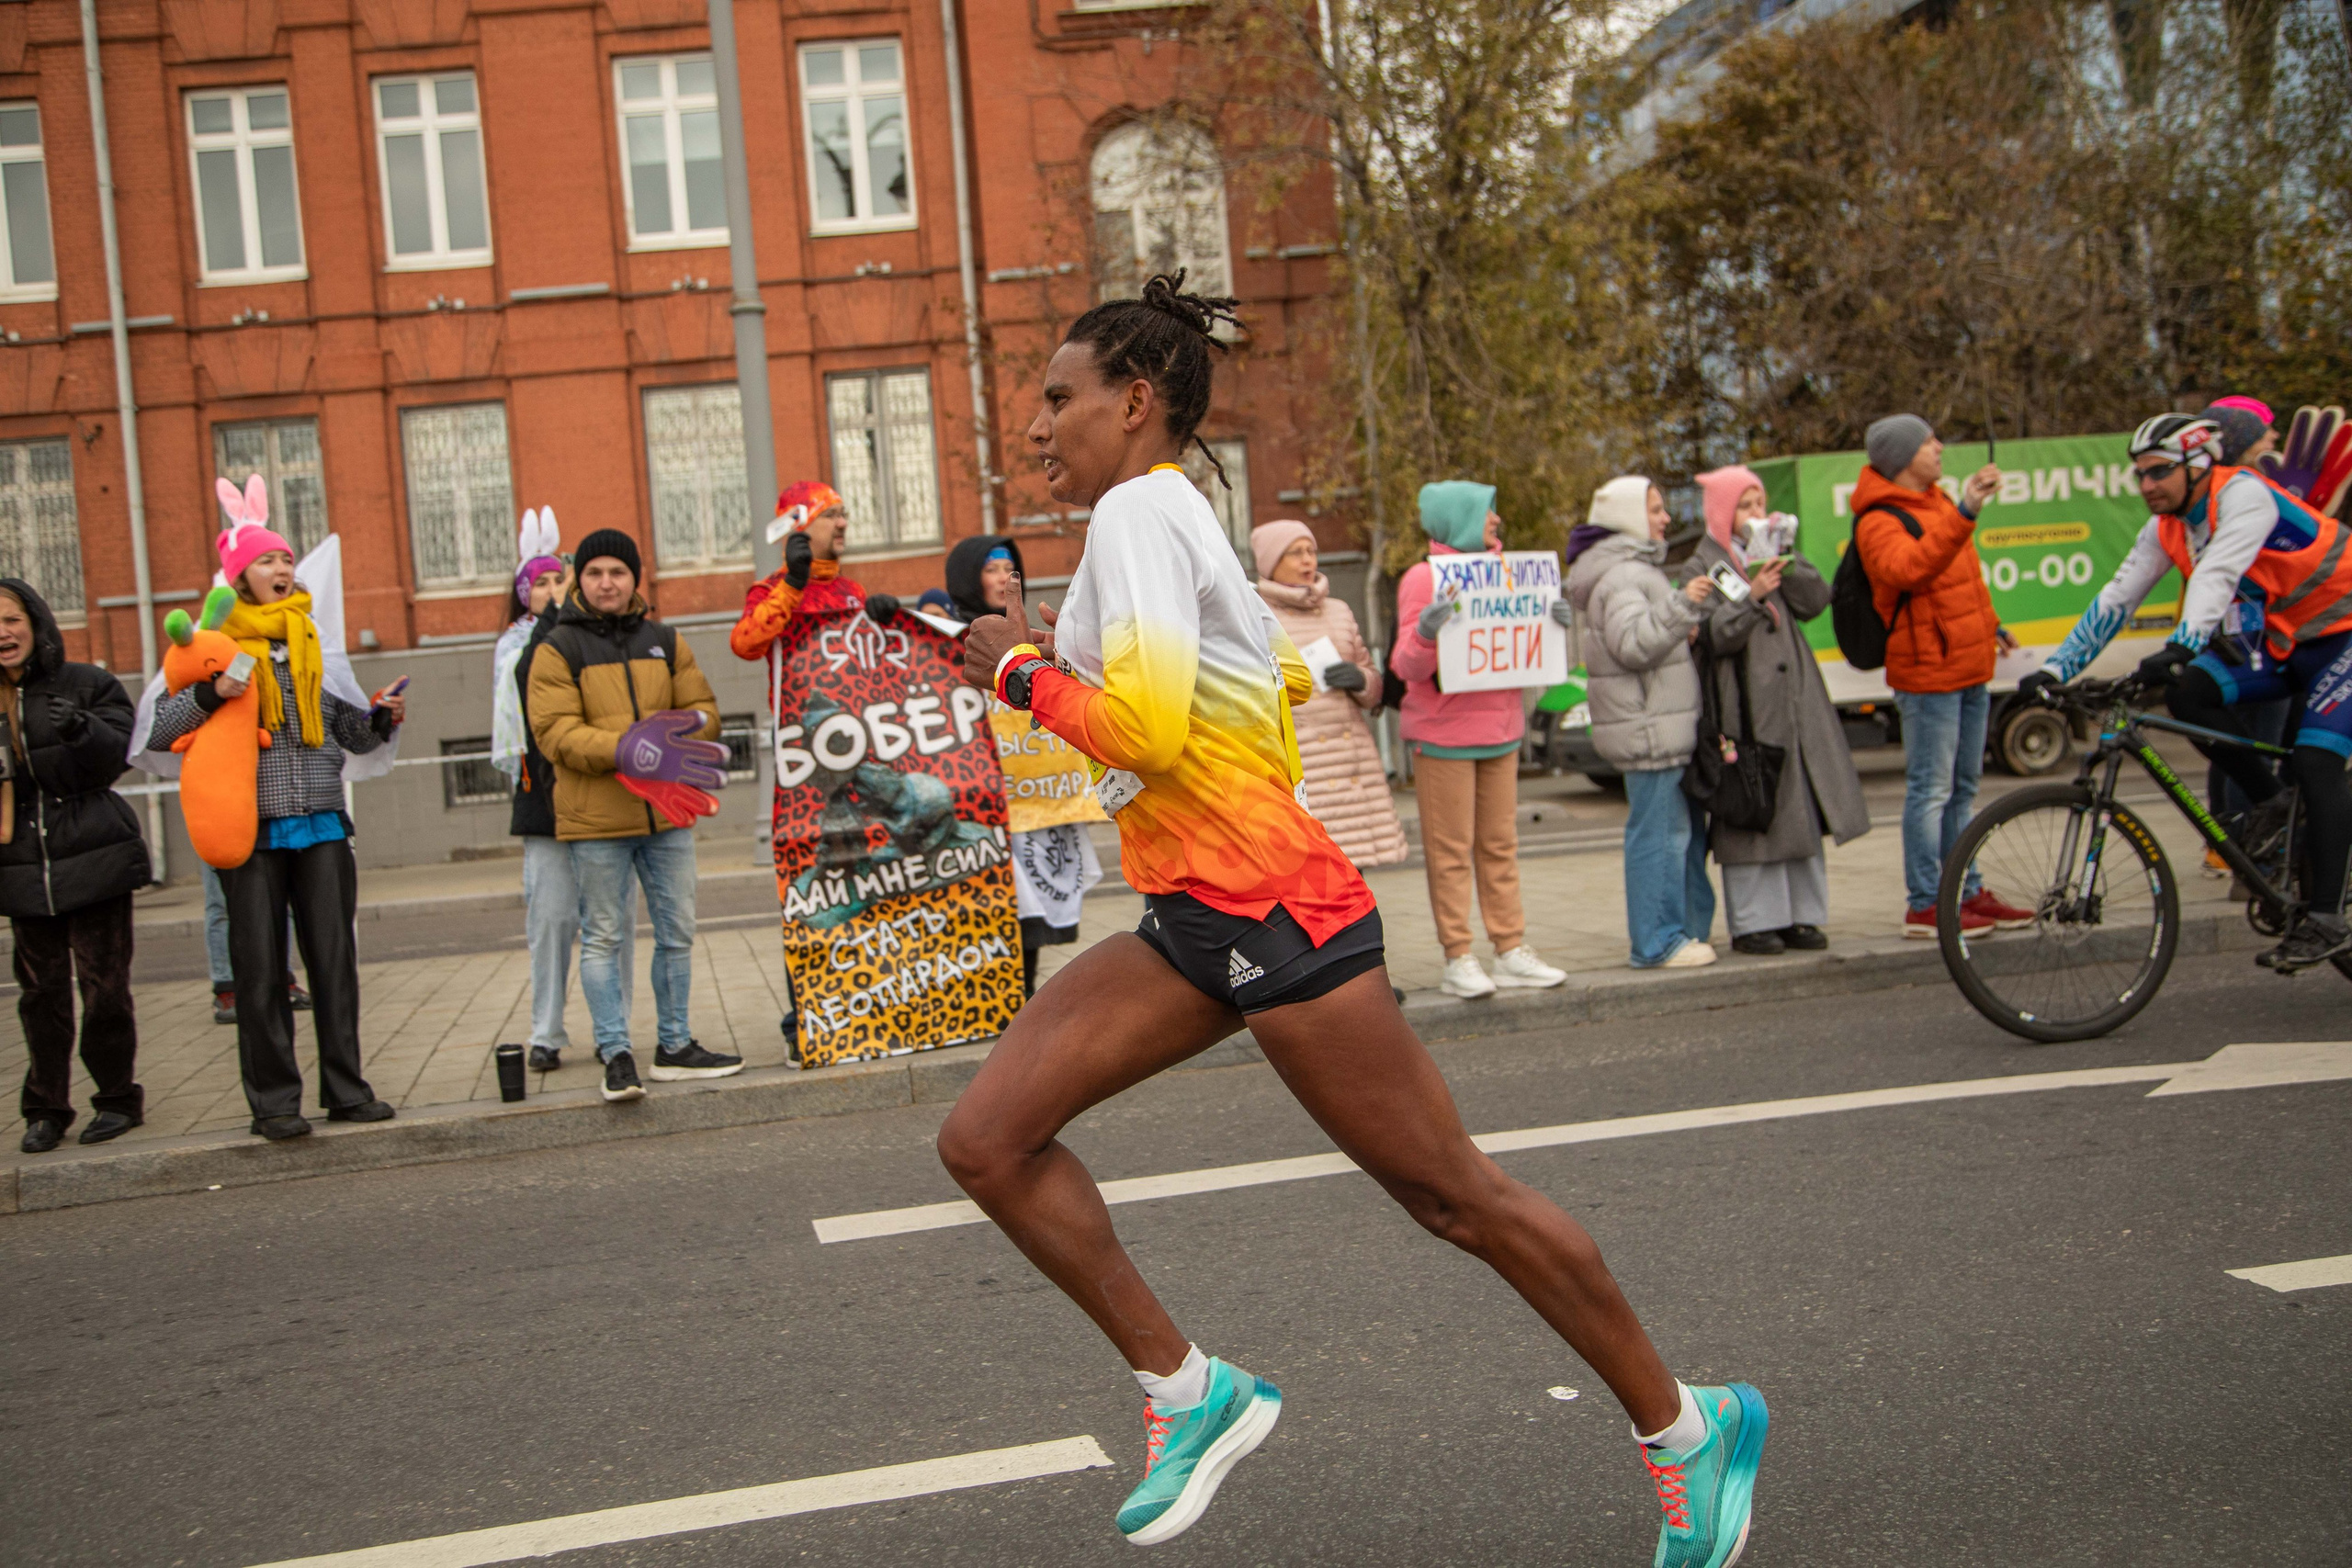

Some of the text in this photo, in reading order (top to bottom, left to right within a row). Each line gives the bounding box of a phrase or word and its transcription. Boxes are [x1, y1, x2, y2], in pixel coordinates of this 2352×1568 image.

[1436, 558, 1559, 592] ХВАТИТ ЧИТАТЬ
[1472, 593, 1546, 620] ПЛАКАТЫ
[1468, 623, 1543, 675] БЕГИ
[775, 682, 985, 788] БОБЁР
[783, 867, 851, 923] ДАЙ
[854, 854, 931, 900] МНЕ
[936, 825, 1012, 879] СИЛ!
[830, 907, 948, 971] СТАТЬ
[804, 935, 1012, 1040] ЛЕОПАРДОМ
[1229, 965, 1264, 988] adidas
